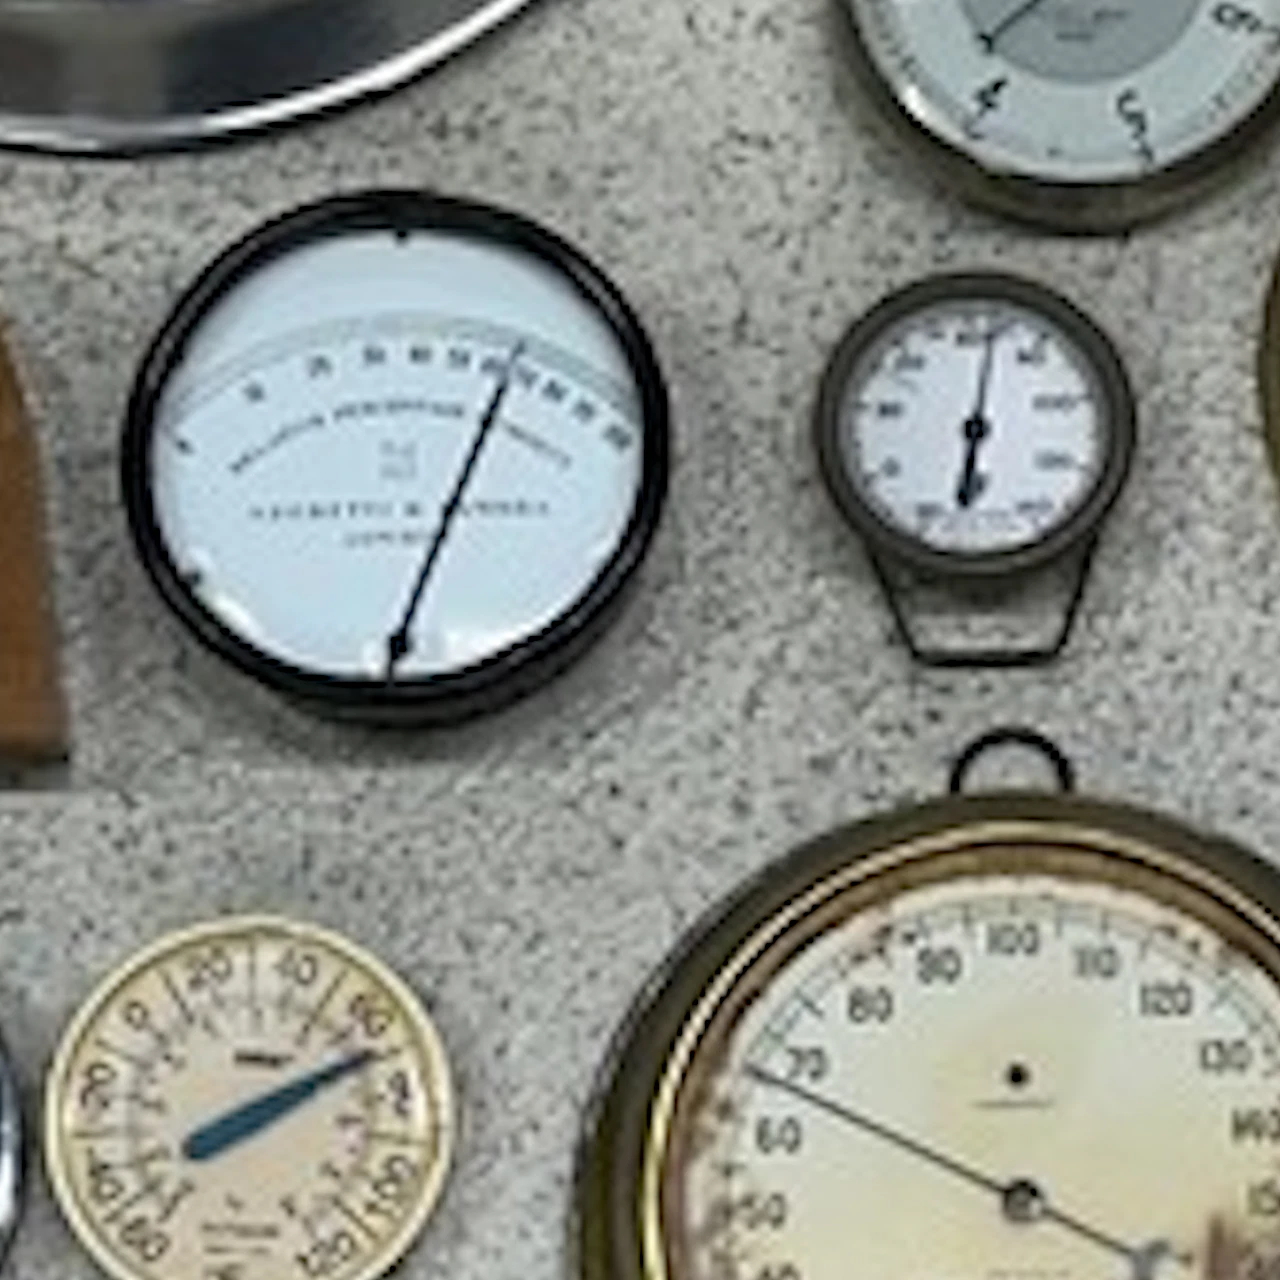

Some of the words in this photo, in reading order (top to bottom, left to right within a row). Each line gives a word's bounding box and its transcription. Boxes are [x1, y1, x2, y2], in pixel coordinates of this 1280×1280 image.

[983, 923, 1042, 957] 100
[184, 947, 234, 992] 20
[274, 949, 320, 986] 40
[917, 947, 964, 984] 90
[1072, 948, 1119, 980] 110
[124, 999, 150, 1032] 0
[1135, 981, 1195, 1019] 120
[786, 1046, 829, 1082] 70
[1197, 1039, 1253, 1074] 130
[741, 1192, 788, 1230] 50
